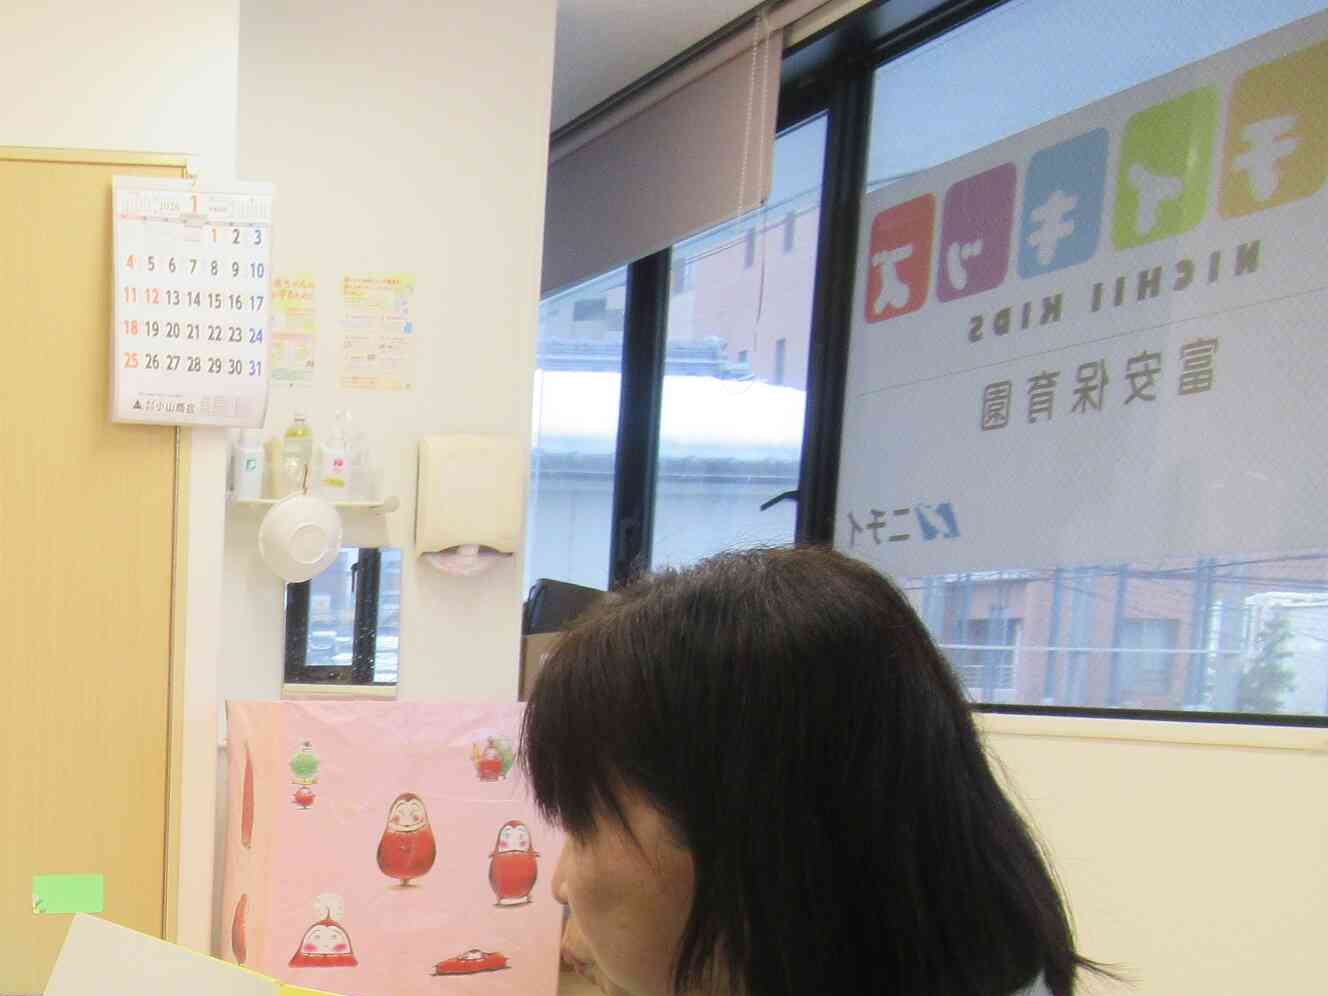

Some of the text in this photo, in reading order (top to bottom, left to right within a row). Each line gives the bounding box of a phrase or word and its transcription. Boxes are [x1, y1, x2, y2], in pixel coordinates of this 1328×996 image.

[211, 228, 262, 245] 1 2 3
[126, 254, 265, 279] 4 5 6 7 8 9 10
[124, 287, 264, 311] 11 12 13 14 15 16 17
[124, 320, 263, 344] 18 19 20 21 22 23 24
[124, 352, 262, 376] 25 26 27 28 29 30 31
